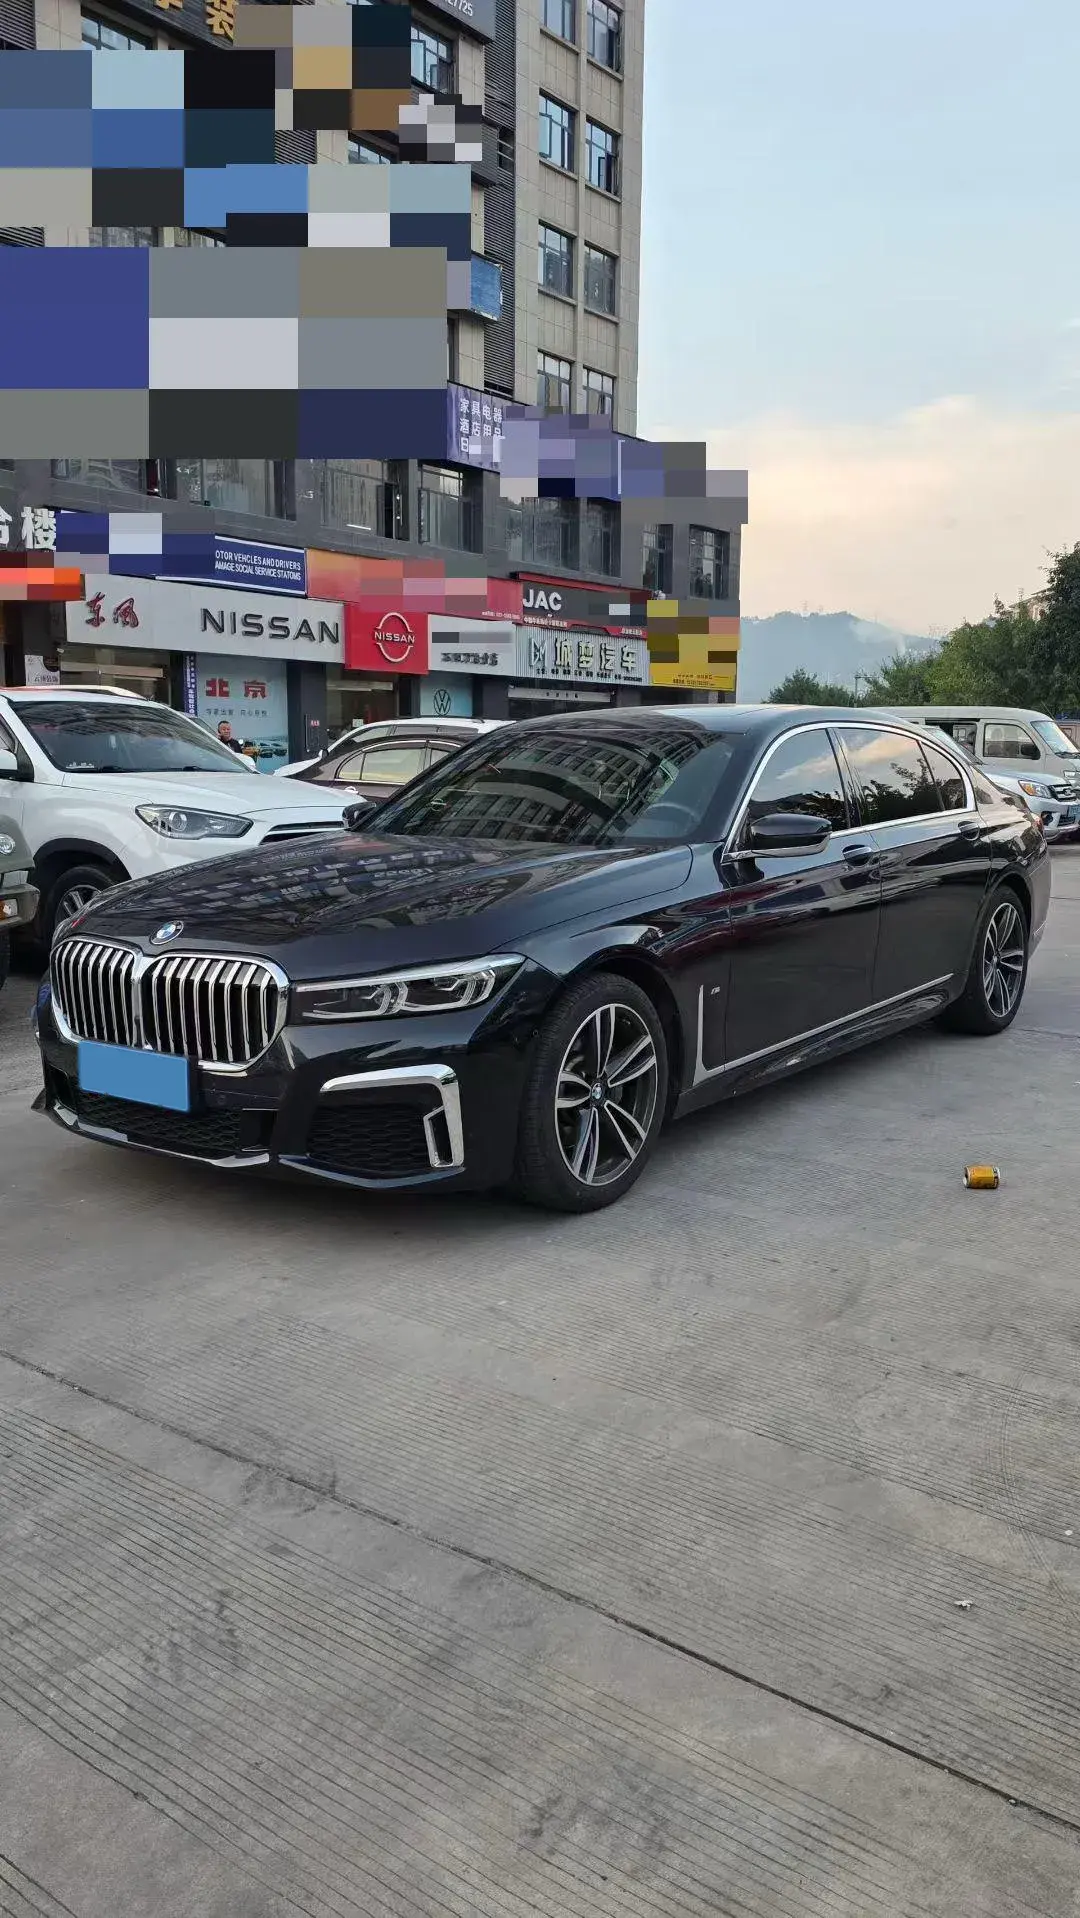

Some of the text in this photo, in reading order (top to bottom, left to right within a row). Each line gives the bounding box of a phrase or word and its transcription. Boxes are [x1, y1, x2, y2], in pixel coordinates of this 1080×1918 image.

[460, 398, 502, 423] 家具电器
[235, 563, 254, 575] SOCIAL
[255, 566, 277, 578] SERVICE
[275, 559, 301, 571] DRIVERS
[522, 588, 562, 611] JAC
[201, 607, 340, 644] NISSAN
[374, 630, 415, 644] NISSAN
[555, 637, 638, 674] 城梦汽车
[206, 678, 267, 699] 北京
